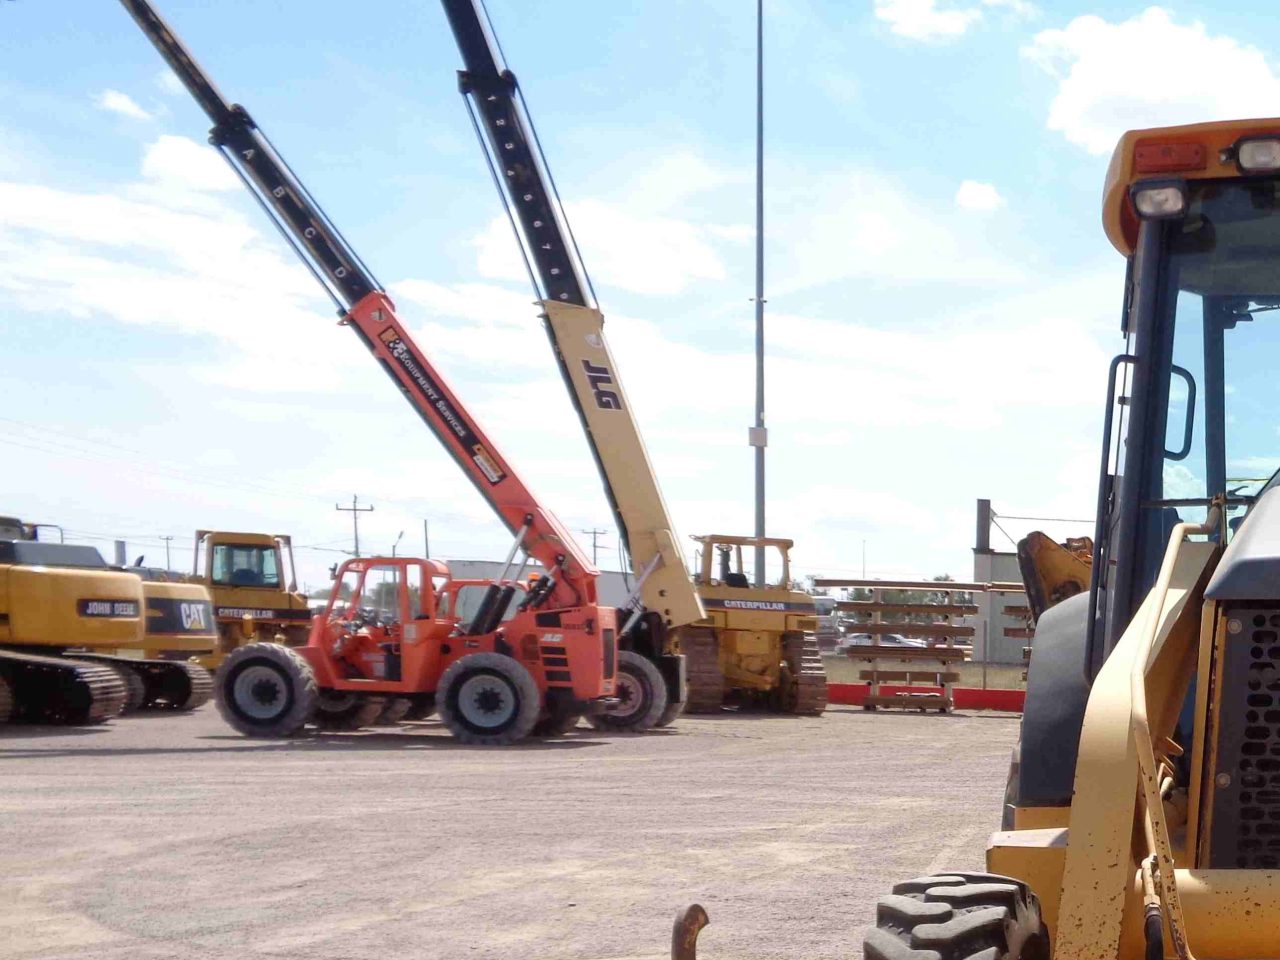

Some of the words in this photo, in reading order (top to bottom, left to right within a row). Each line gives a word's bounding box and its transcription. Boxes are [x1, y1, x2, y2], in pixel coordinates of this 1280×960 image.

[242, 149, 254, 160] A
[272, 186, 285, 198] B
[304, 227, 316, 239] C
[334, 266, 346, 278] D
[541, 242, 552, 250] 7
[581, 359, 622, 410] JLG
[86, 602, 110, 614] JOHN
[114, 603, 136, 615] DEERE
[723, 600, 785, 610] CATERPILLAR
[180, 602, 206, 629] CAT
